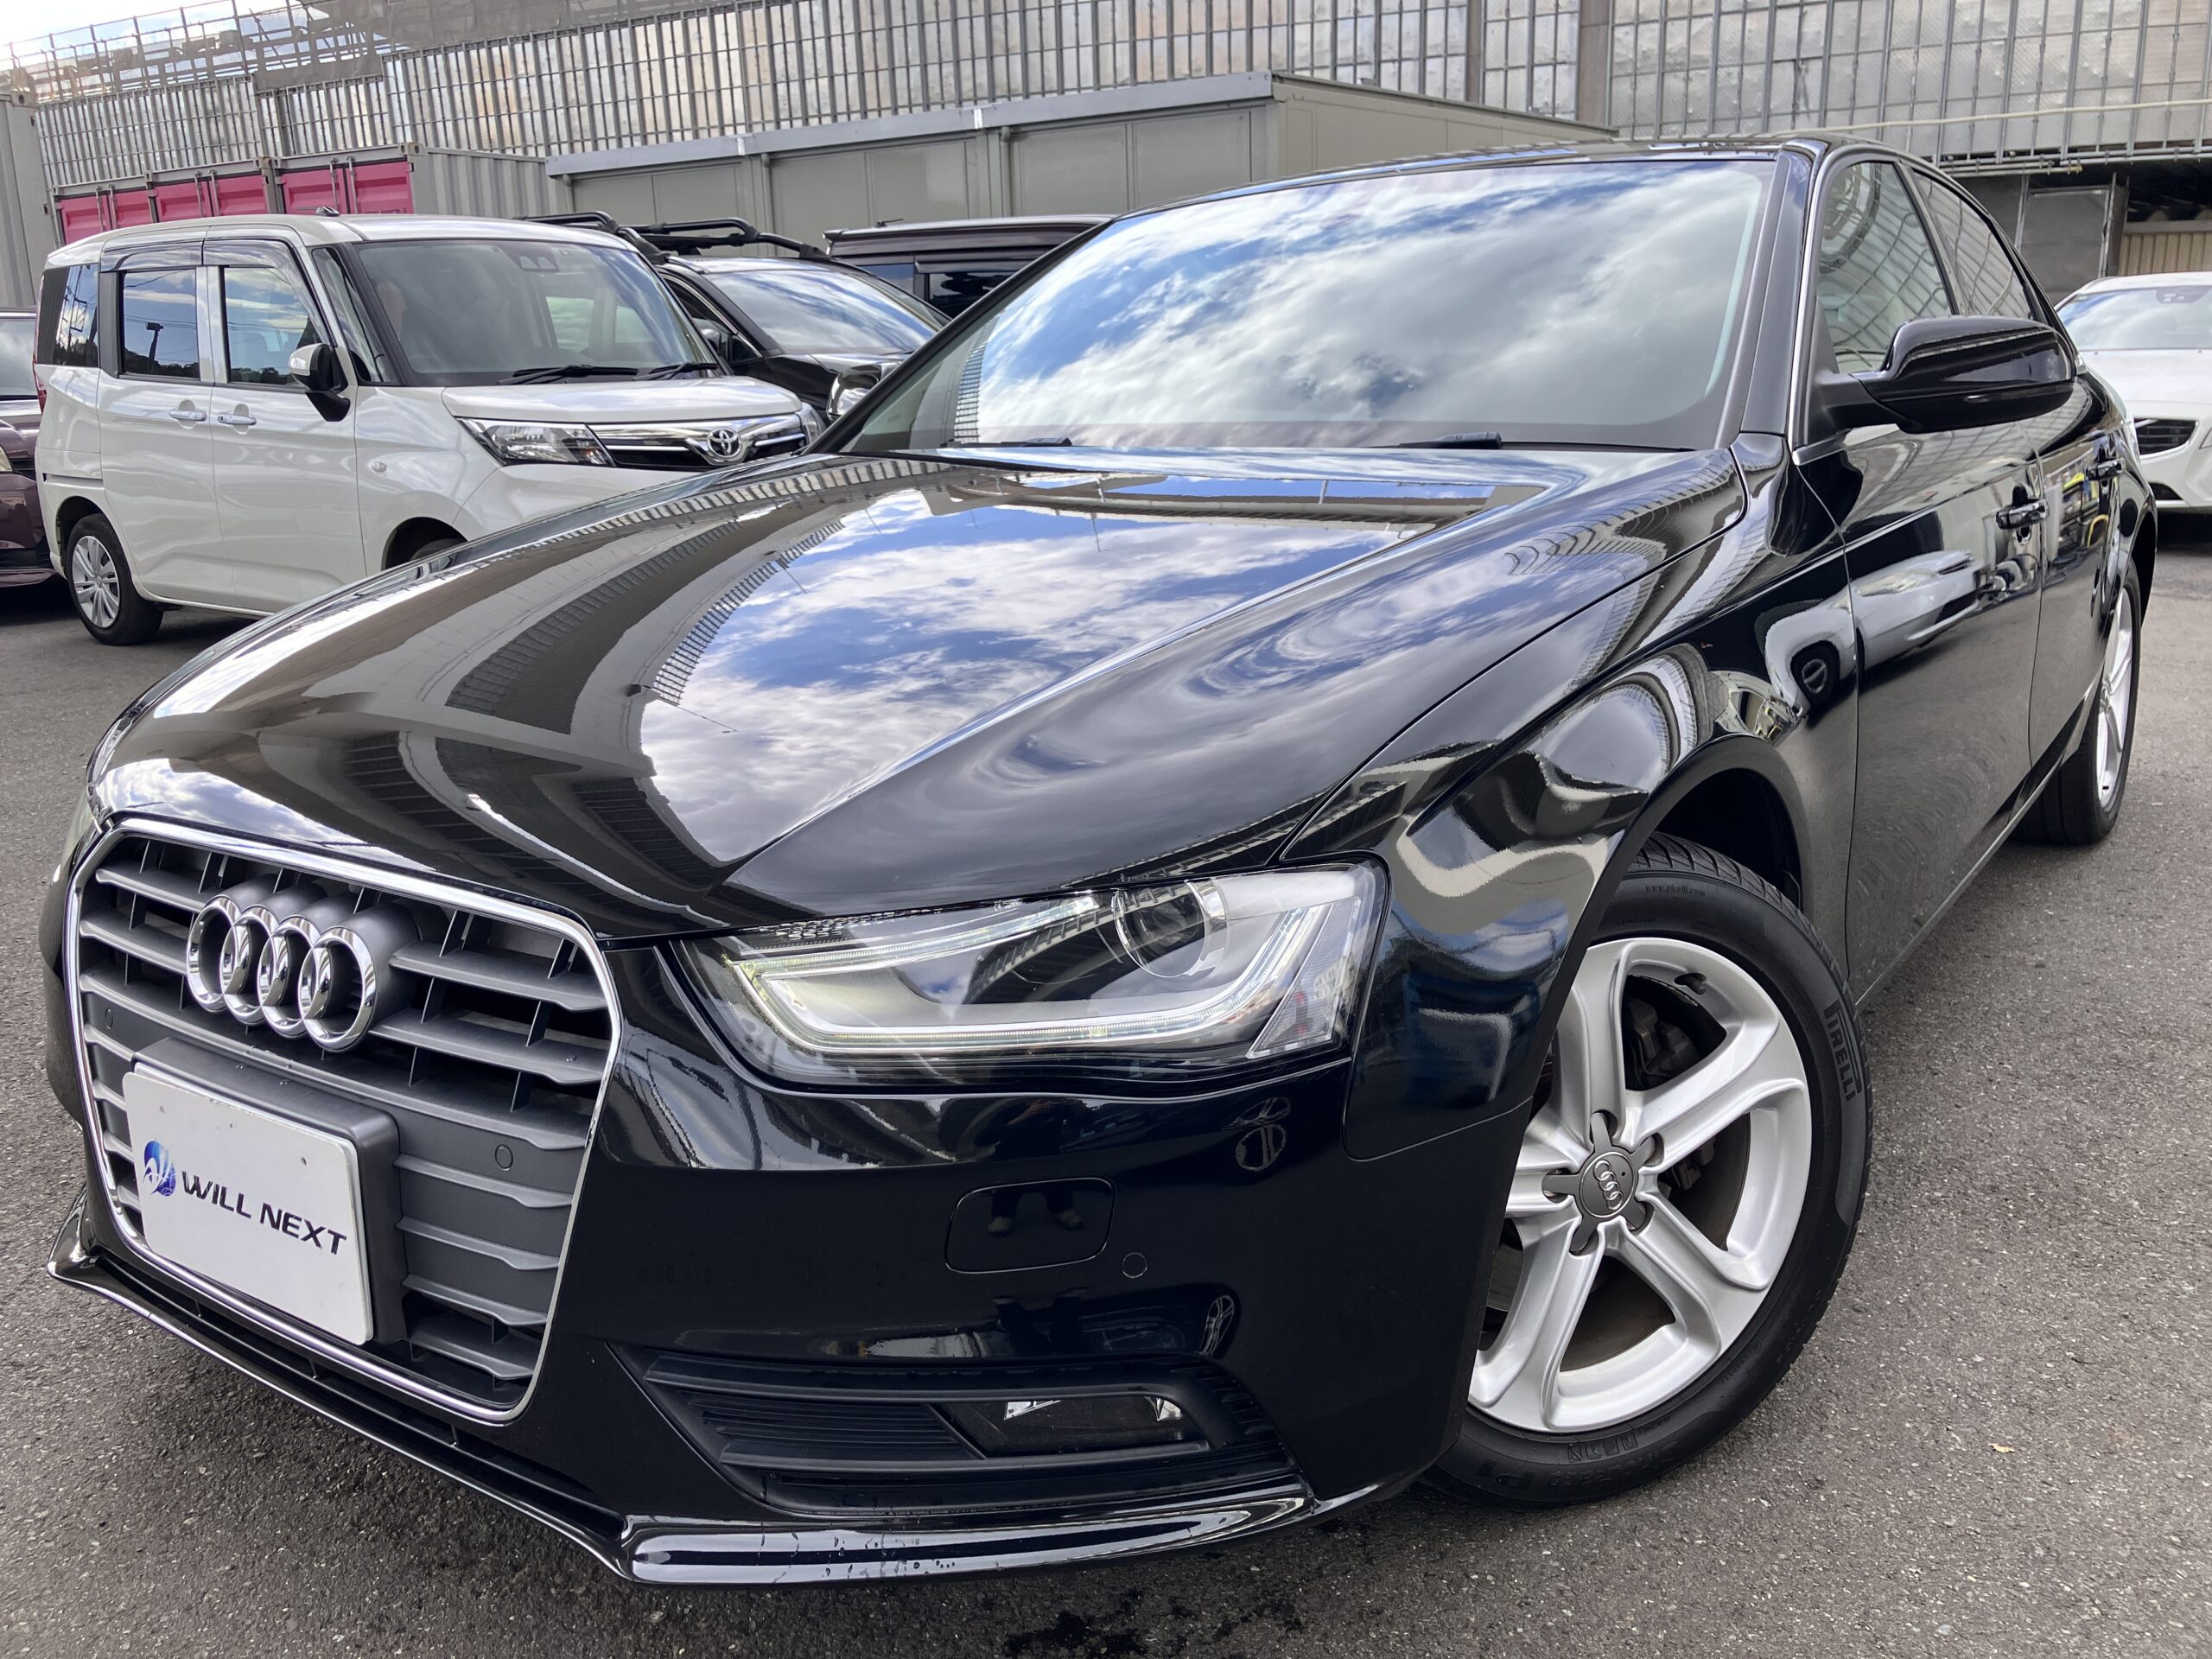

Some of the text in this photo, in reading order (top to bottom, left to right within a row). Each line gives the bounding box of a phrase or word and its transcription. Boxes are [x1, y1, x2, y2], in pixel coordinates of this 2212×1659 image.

[1644, 884, 1706, 897] www.pirelli.com
[1823, 997, 1863, 1102] PIRELLI
[181, 1170, 347, 1255] WILL NEXT
